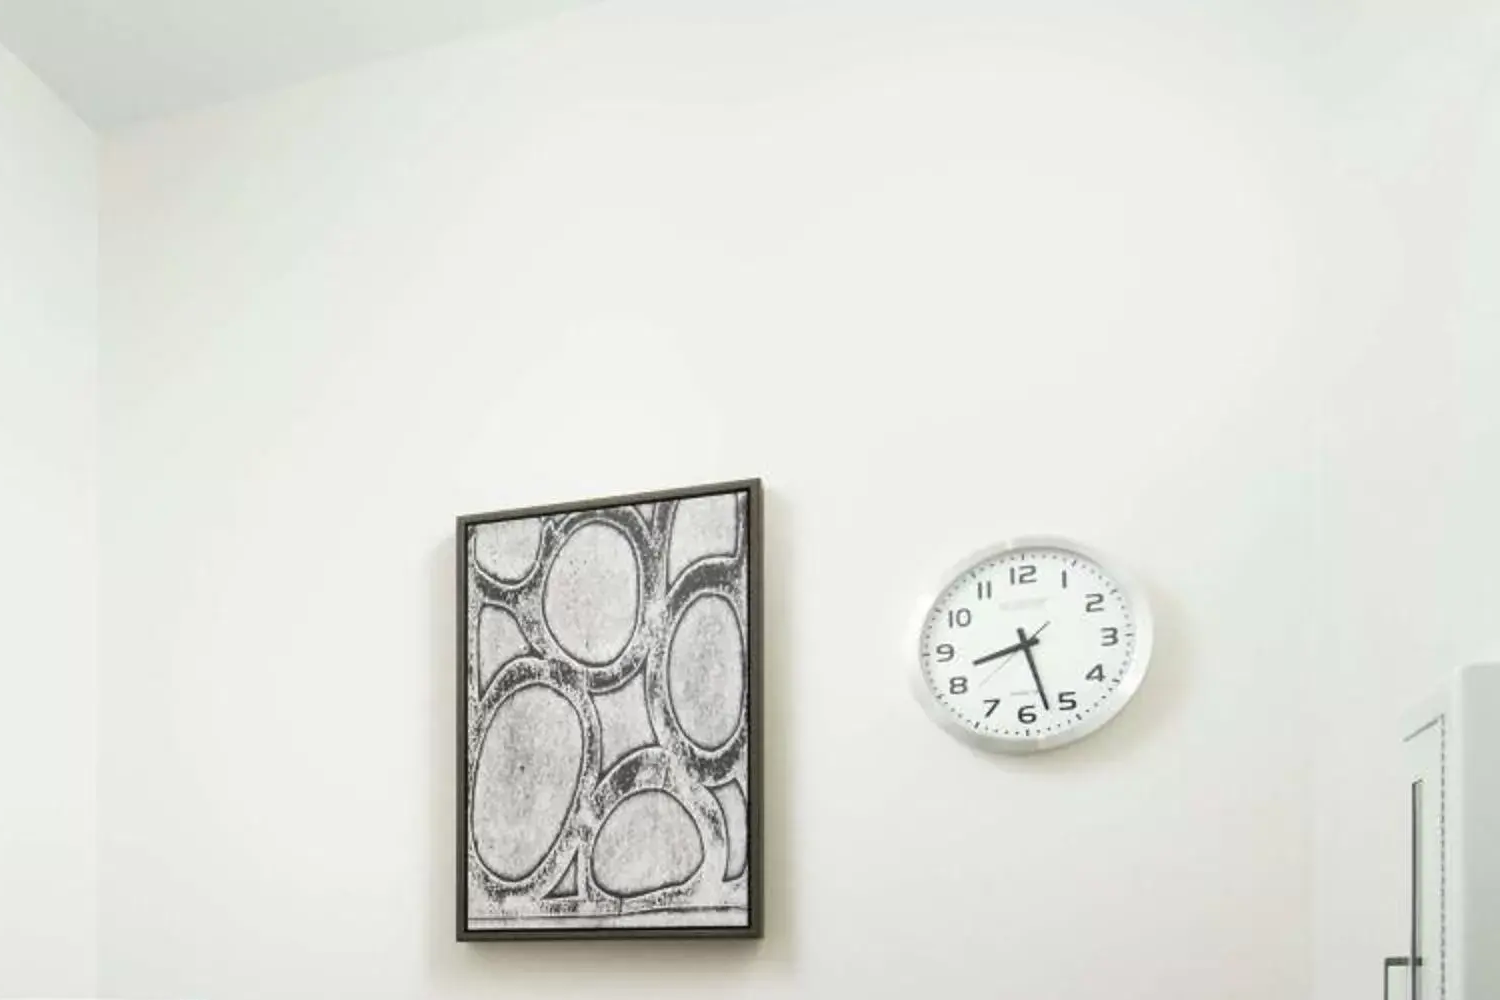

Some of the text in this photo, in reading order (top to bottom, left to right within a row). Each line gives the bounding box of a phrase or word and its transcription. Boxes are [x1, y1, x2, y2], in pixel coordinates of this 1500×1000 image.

[1009, 565, 1037, 585] 12
[1061, 569, 1068, 589] 1
[977, 580, 992, 600] 11
[1085, 593, 1105, 613] 2
[948, 608, 972, 628] 10
[1100, 627, 1119, 647] 3
[936, 643, 955, 662] 9
[1085, 664, 1106, 682] 4
[949, 676, 968, 695] 8
[983, 698, 1001, 718] 7
[1058, 691, 1077, 711] 5
[1017, 705, 1037, 724] 6
